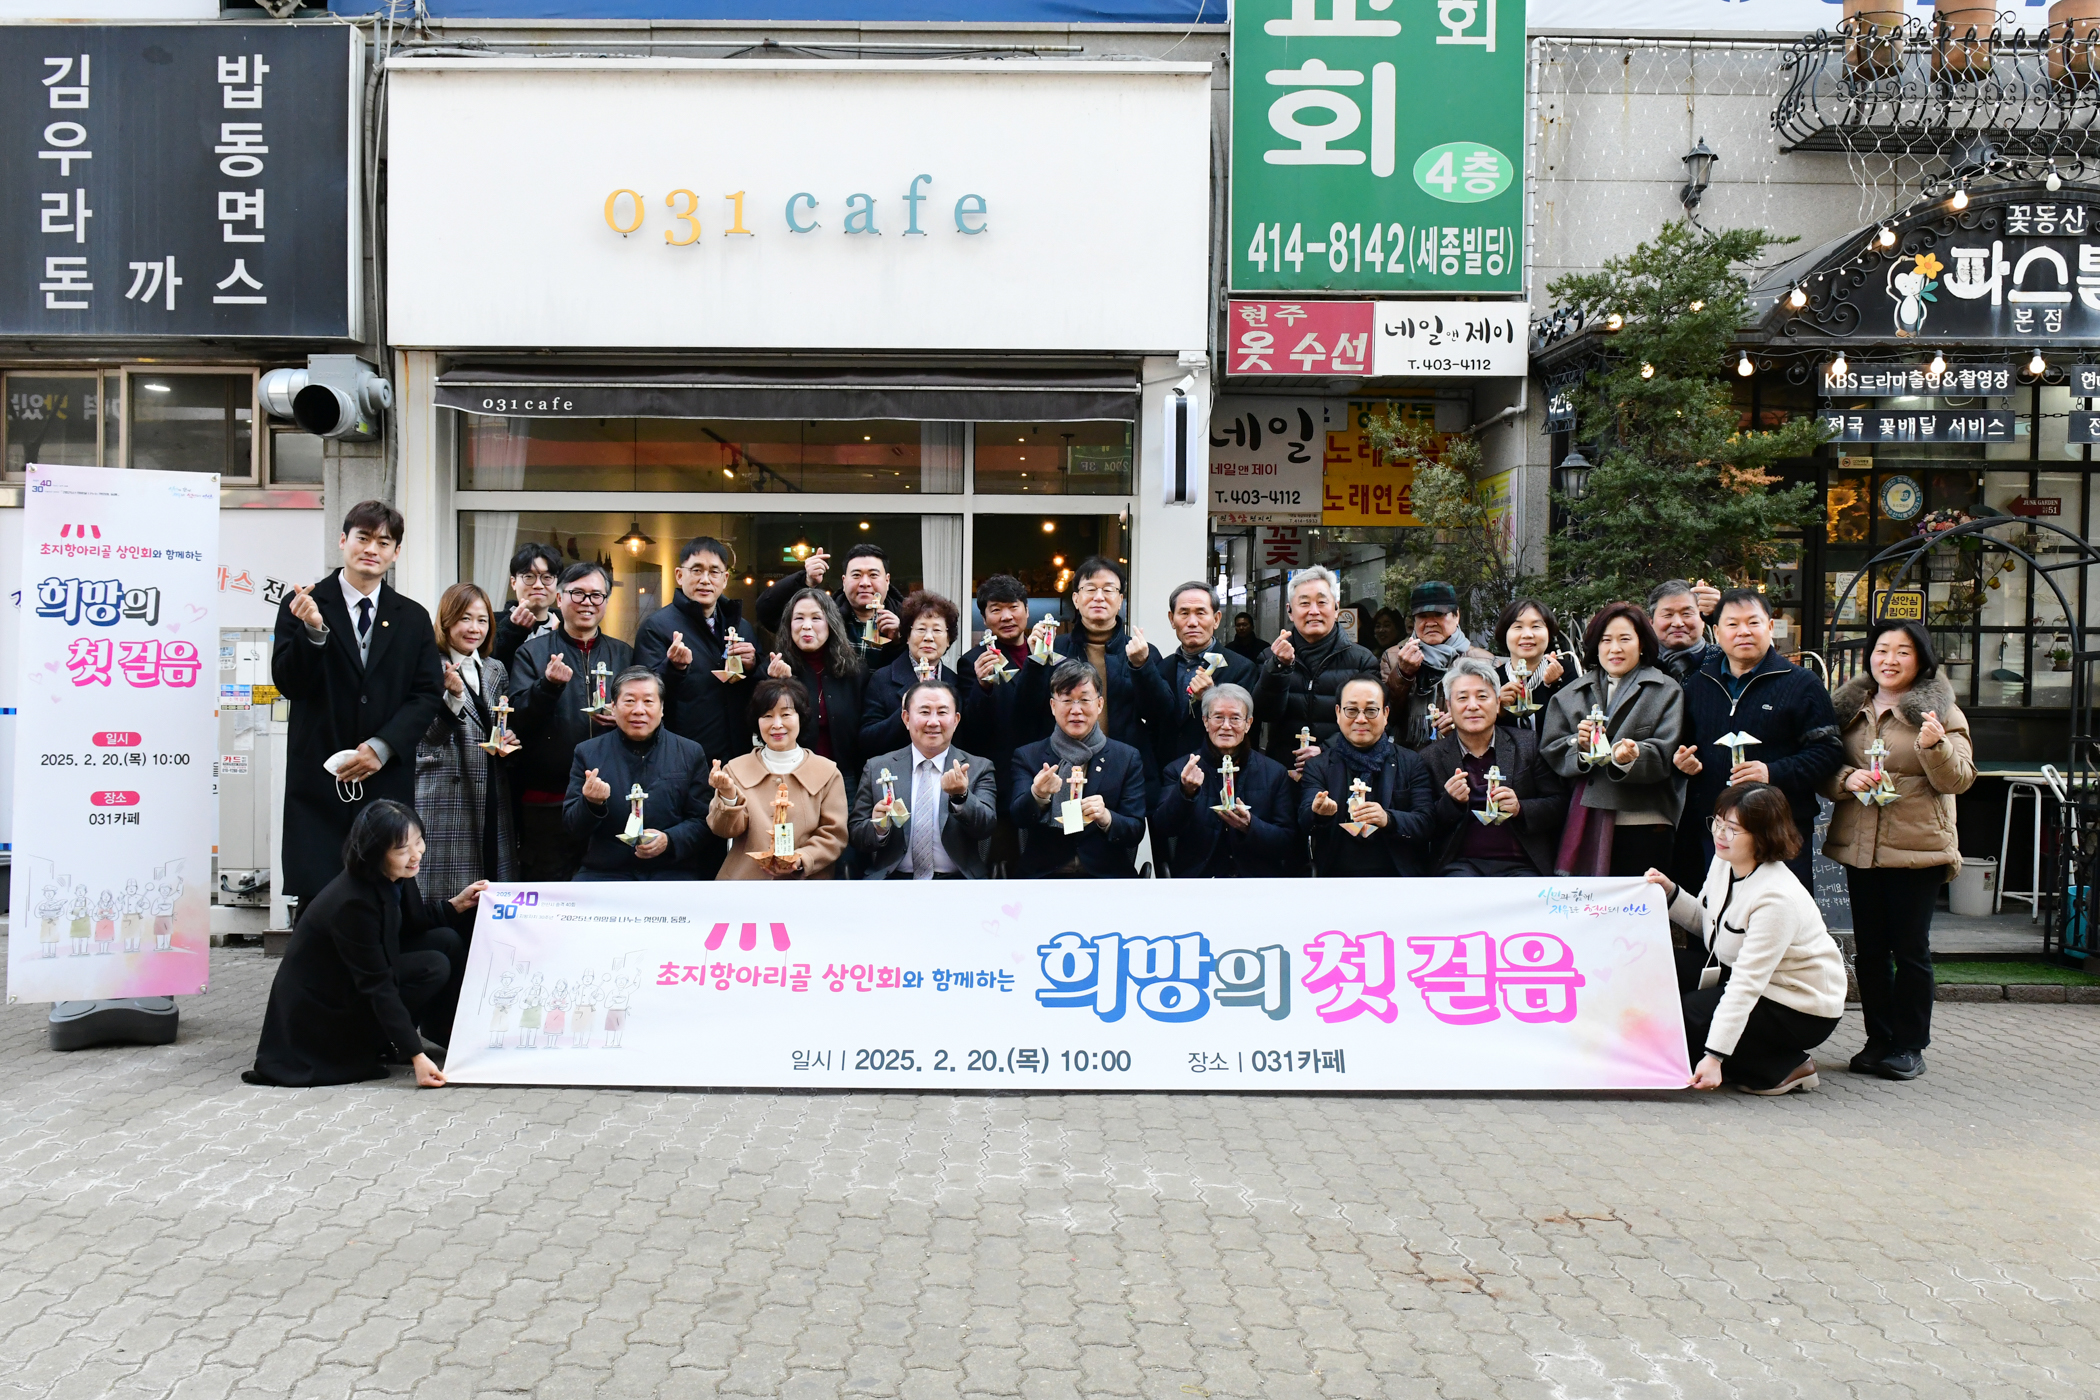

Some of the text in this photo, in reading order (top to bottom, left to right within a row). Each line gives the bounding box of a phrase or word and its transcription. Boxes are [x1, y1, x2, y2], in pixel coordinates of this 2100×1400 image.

[1425, 151, 1500, 195] 4층
[604, 173, 988, 247] 031cafe
[2006, 205, 2087, 234] 꽃동산
[1248, 221, 1514, 276] 414-8142(세종빌딩)
[1238, 303, 1308, 328] 현주
[483, 396, 574, 412] 031cafe
[1209, 407, 1315, 464] 네일
[1827, 415, 2005, 436] 전국 꽃배달 서비스
[1214, 490, 1301, 505] T.403-4112
[40, 543, 203, 561] 초지항아리골 상인회와 함께하는
[1263, 526, 1302, 566] 꽃
[36, 577, 161, 626] 희망의
[105, 733, 129, 745] 일시
[152, 754, 191, 766] 10:00
[104, 792, 127, 804] 장소
[89, 812, 140, 826] 031카페
[511, 891, 539, 907] 40
[1622, 903, 1652, 916] 안산
[491, 904, 518, 920] 30
[655, 962, 1016, 993] 초지항아리골 상인회와 함께하는
[1035, 930, 1292, 1024] 희망의
[791, 1049, 833, 1073] 일시
[854, 1049, 924, 1072] 2025.
[933, 1049, 957, 1072] 2.
[1060, 1050, 1132, 1073] 10:00
[1187, 1048, 1346, 1075] 장소 031카페
